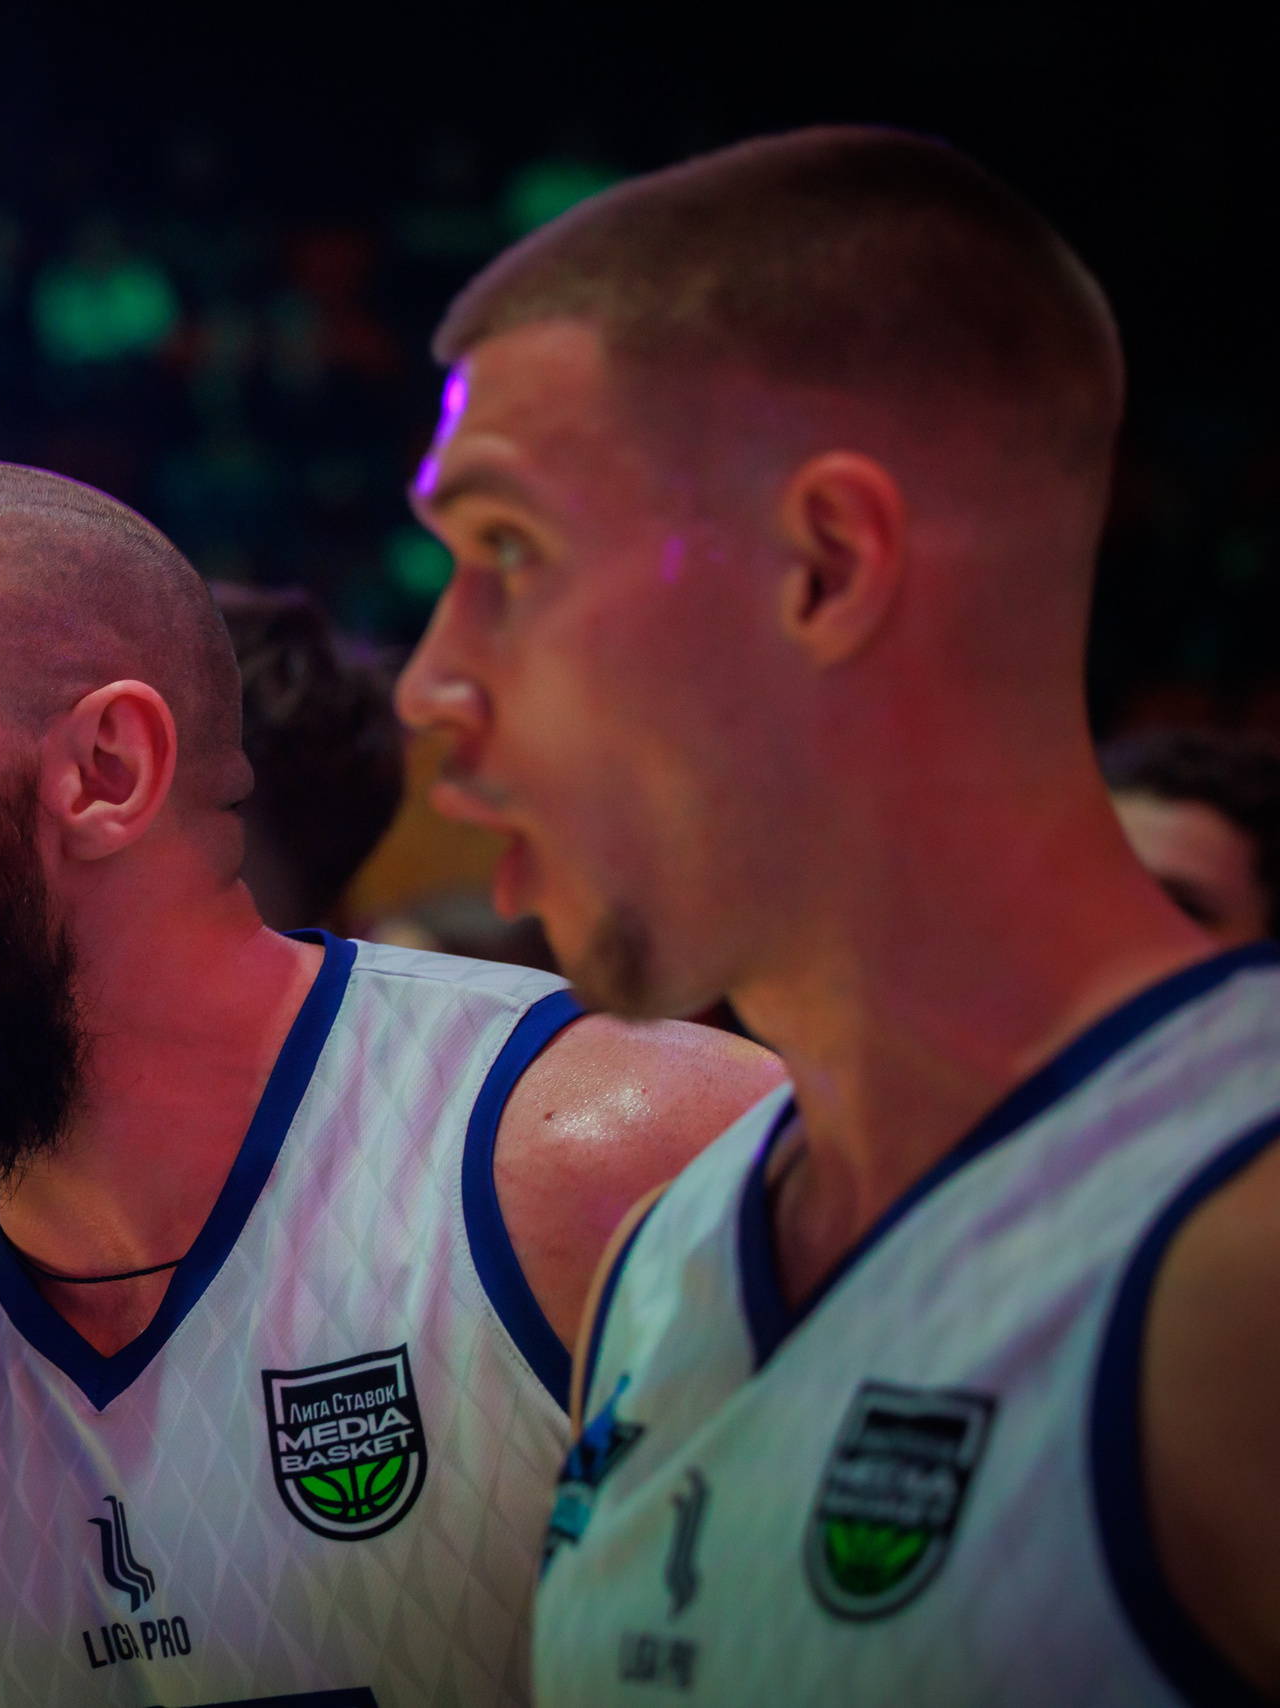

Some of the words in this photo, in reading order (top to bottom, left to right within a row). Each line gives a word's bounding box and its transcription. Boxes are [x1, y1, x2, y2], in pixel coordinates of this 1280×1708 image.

[276, 1407, 412, 1452] MEDIA
[280, 1427, 415, 1473] BASKET
[140, 1616, 191, 1660] PRO
